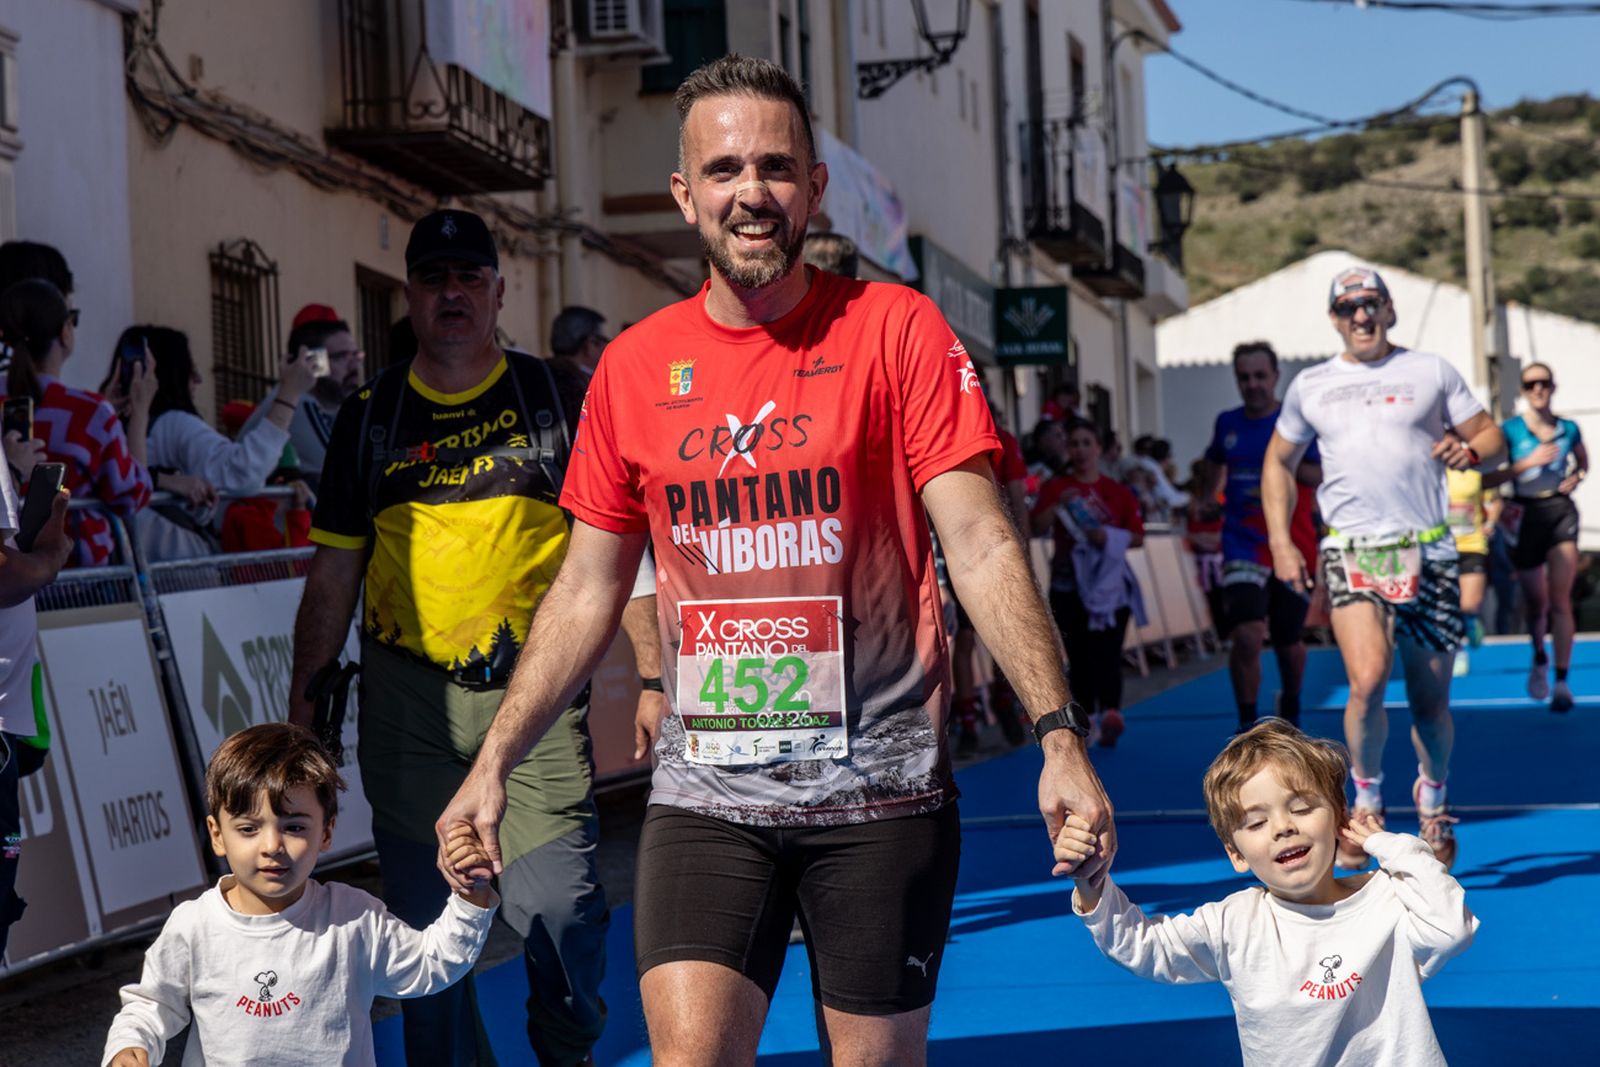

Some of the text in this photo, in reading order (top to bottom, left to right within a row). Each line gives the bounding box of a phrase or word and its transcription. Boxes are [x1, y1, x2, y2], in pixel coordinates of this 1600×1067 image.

[678, 413, 812, 462] CROSS
[665, 465, 842, 527] PANTANO
[671, 516, 844, 575] DEL VÍBORAS
[695, 610, 717, 640] X
[719, 617, 810, 641] CROSS
[695, 640, 788, 661] PANTANO
[699, 655, 811, 713] 452
[88, 679, 138, 755] JAÉN
[691, 717, 737, 730] ANTONIO
[102, 791, 171, 852] MARTOS
[236, 991, 301, 1017] PEANUTS
[1299, 972, 1363, 1000] PEANUTS
